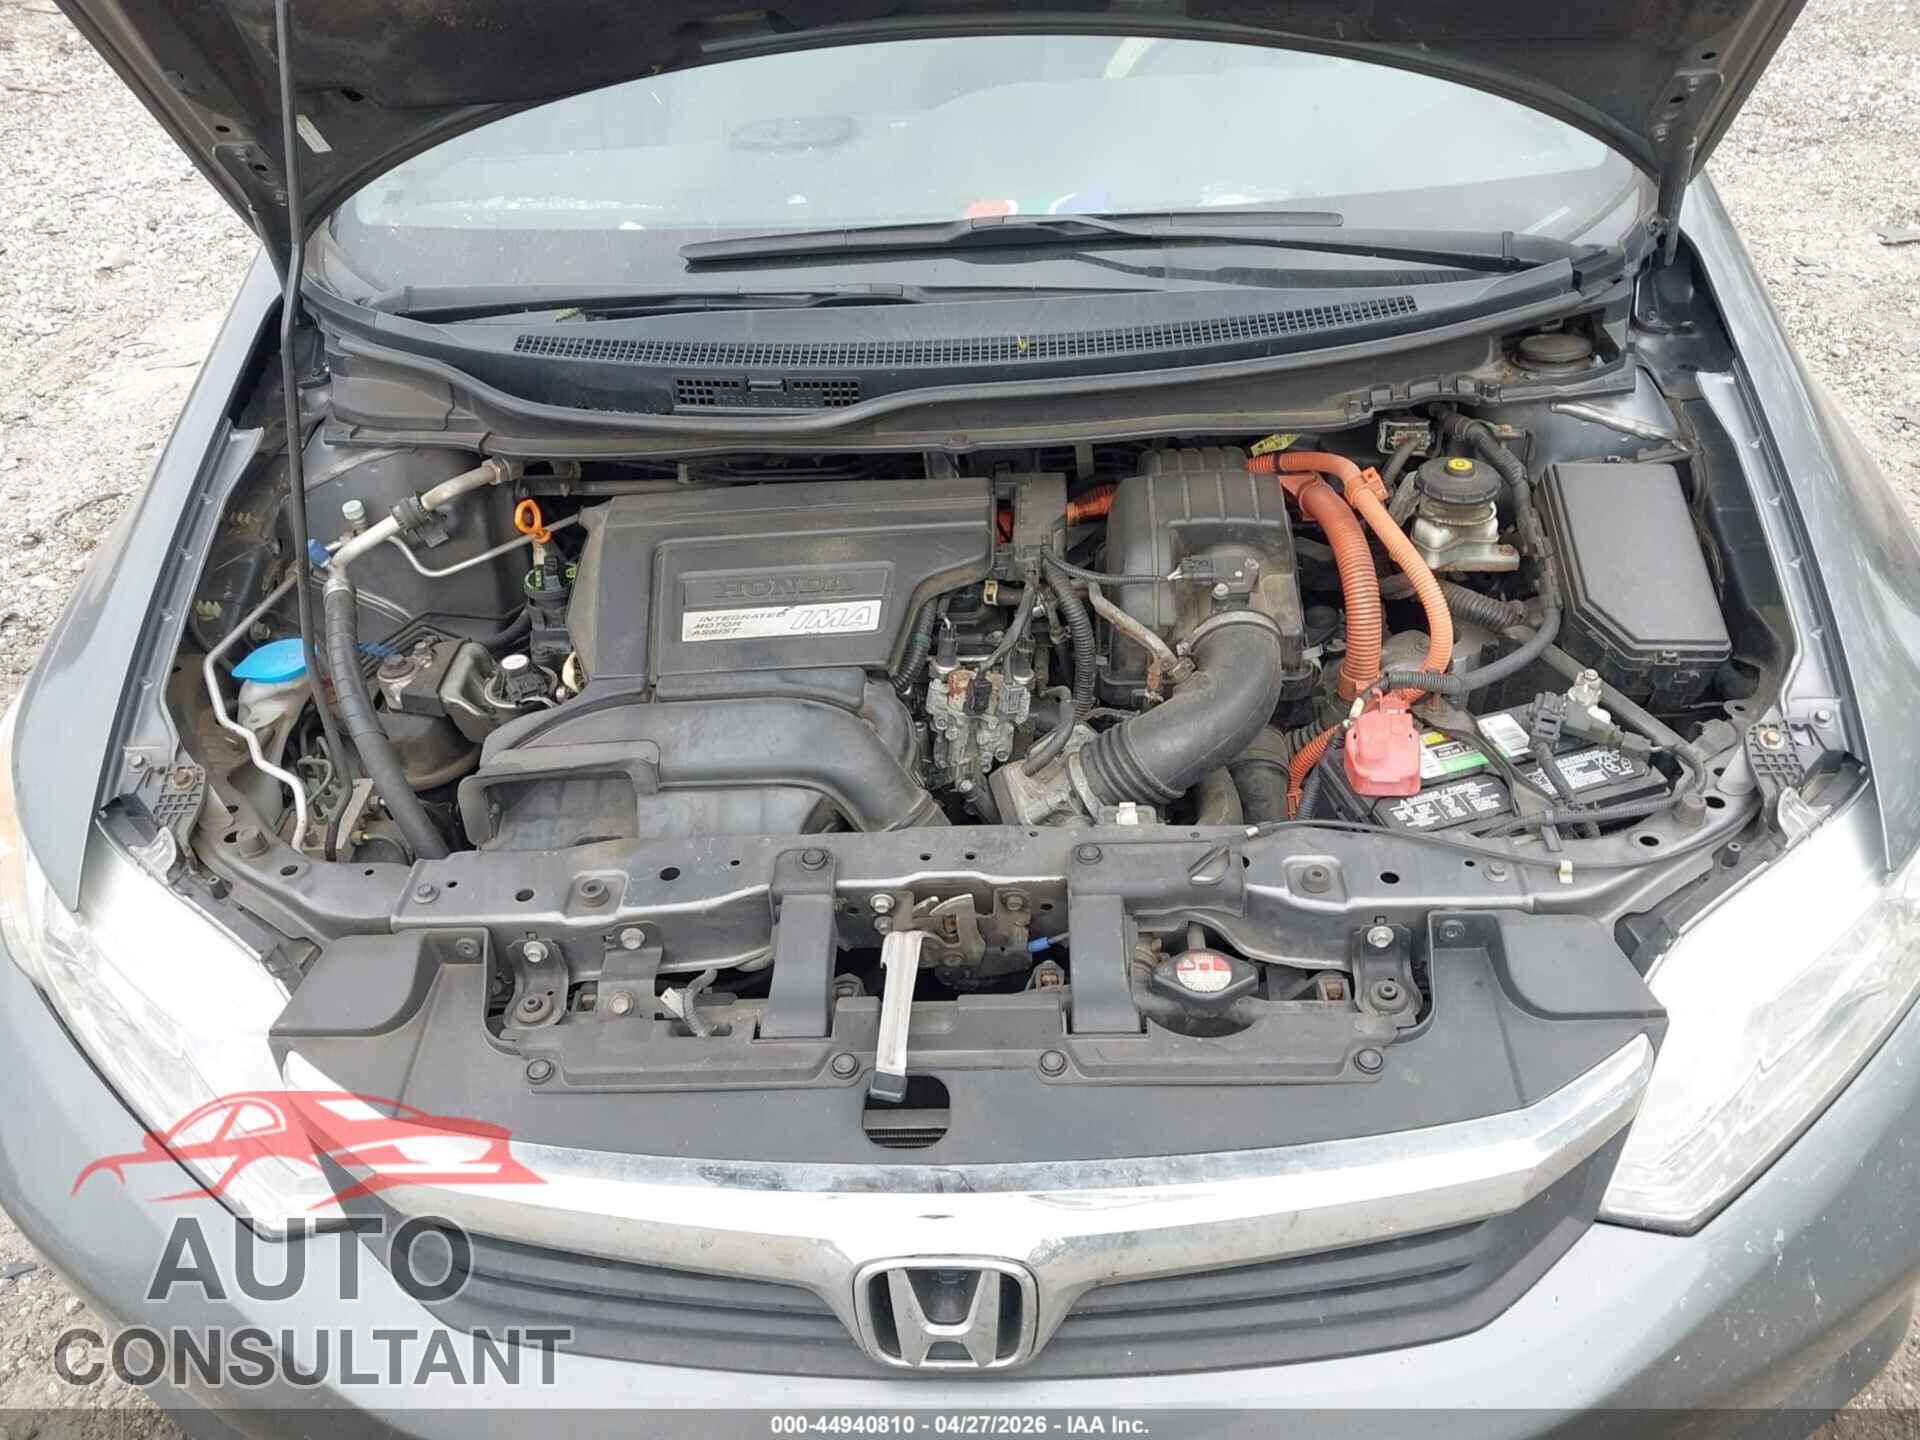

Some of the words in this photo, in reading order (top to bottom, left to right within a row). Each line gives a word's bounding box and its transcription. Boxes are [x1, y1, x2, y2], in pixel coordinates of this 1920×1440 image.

[699, 611, 786, 623] INTEGRATED
[790, 606, 872, 631] IMA
[694, 621, 742, 630] MOTOR
